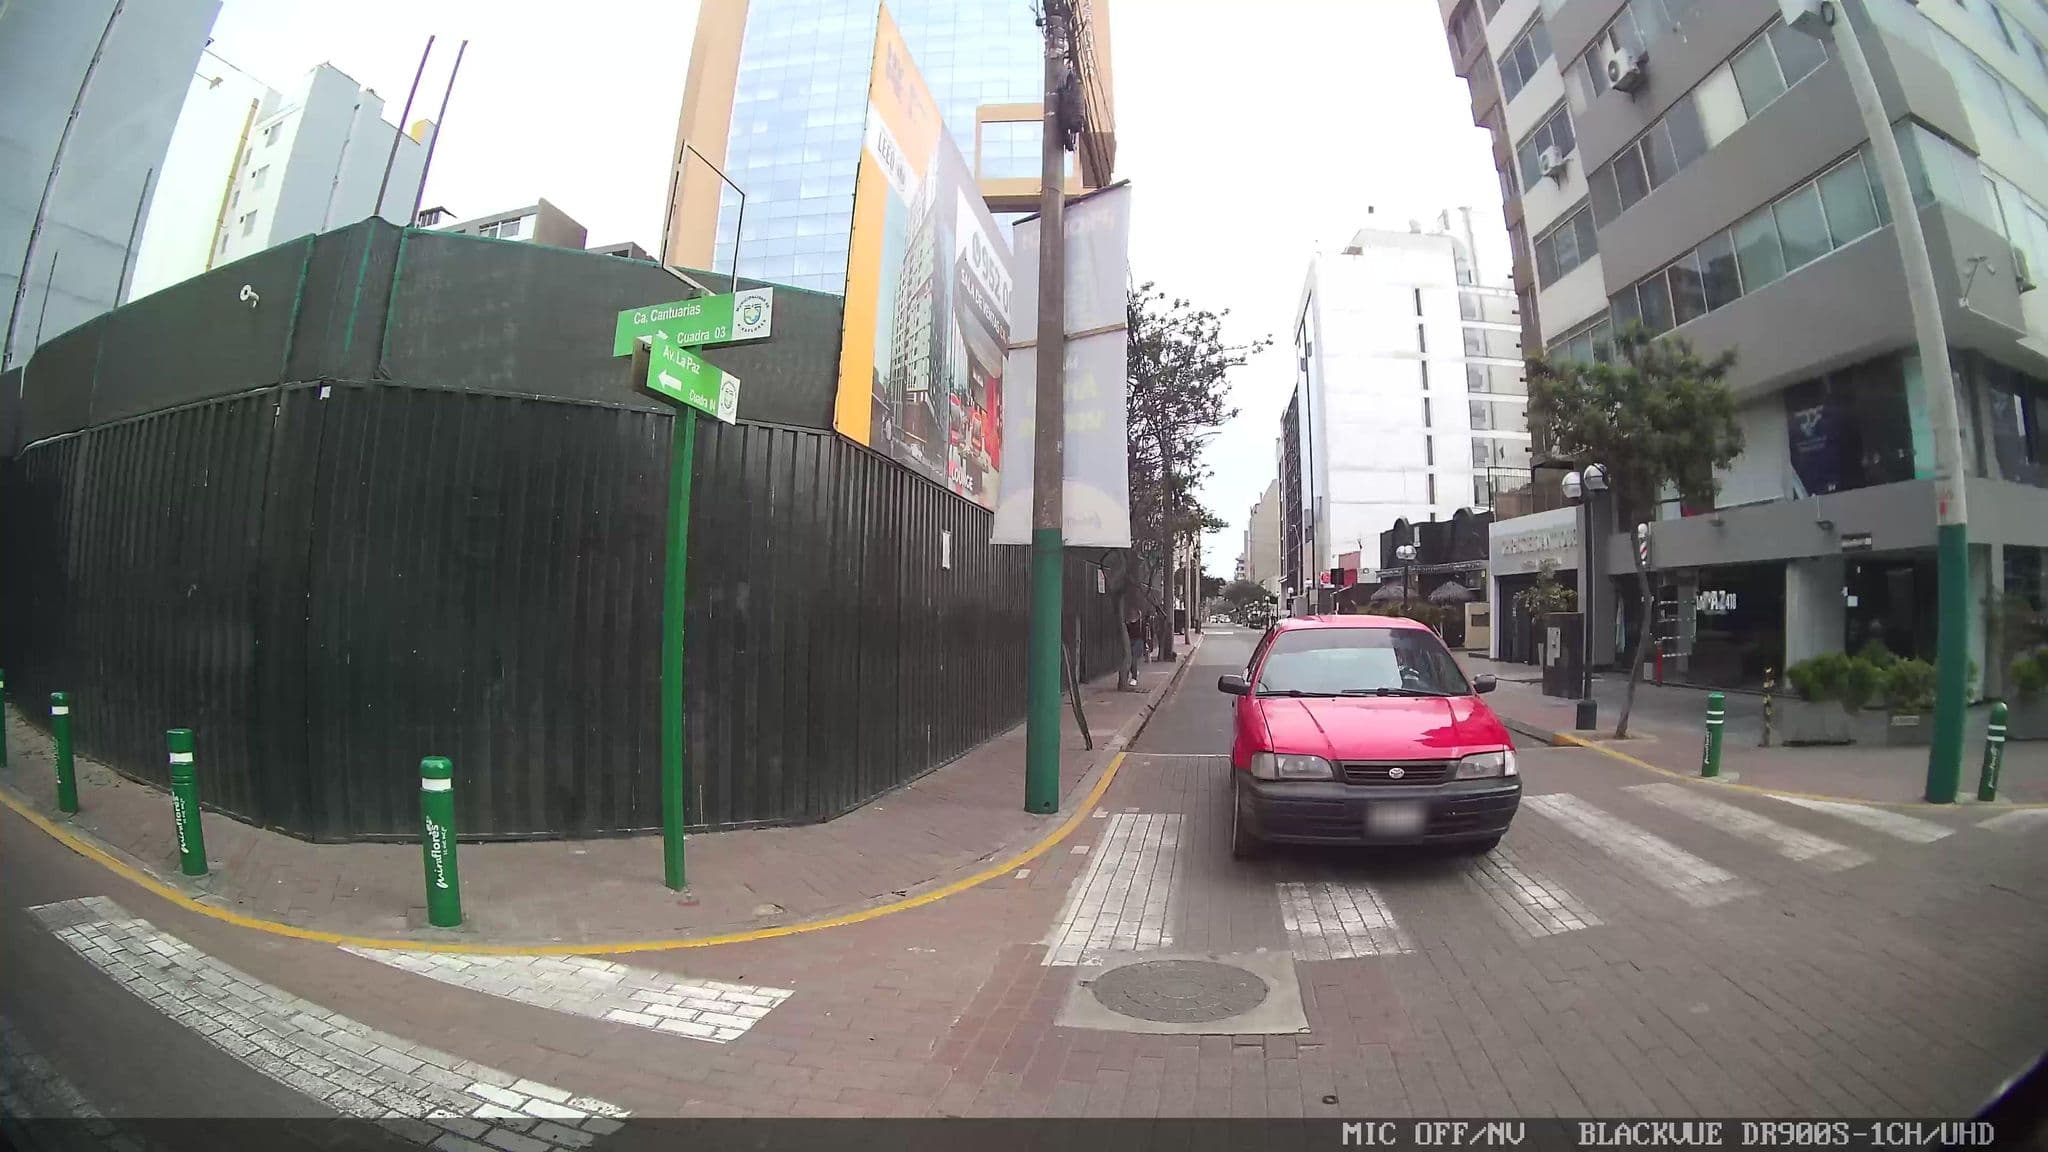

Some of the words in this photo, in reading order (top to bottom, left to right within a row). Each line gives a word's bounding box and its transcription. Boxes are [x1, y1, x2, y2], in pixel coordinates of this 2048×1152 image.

[633, 311, 648, 325] Ca.
[650, 303, 701, 322] Cantuarias
[677, 331, 710, 344] Cuadra
[714, 326, 726, 338] 03
[686, 356, 700, 375] Paz
